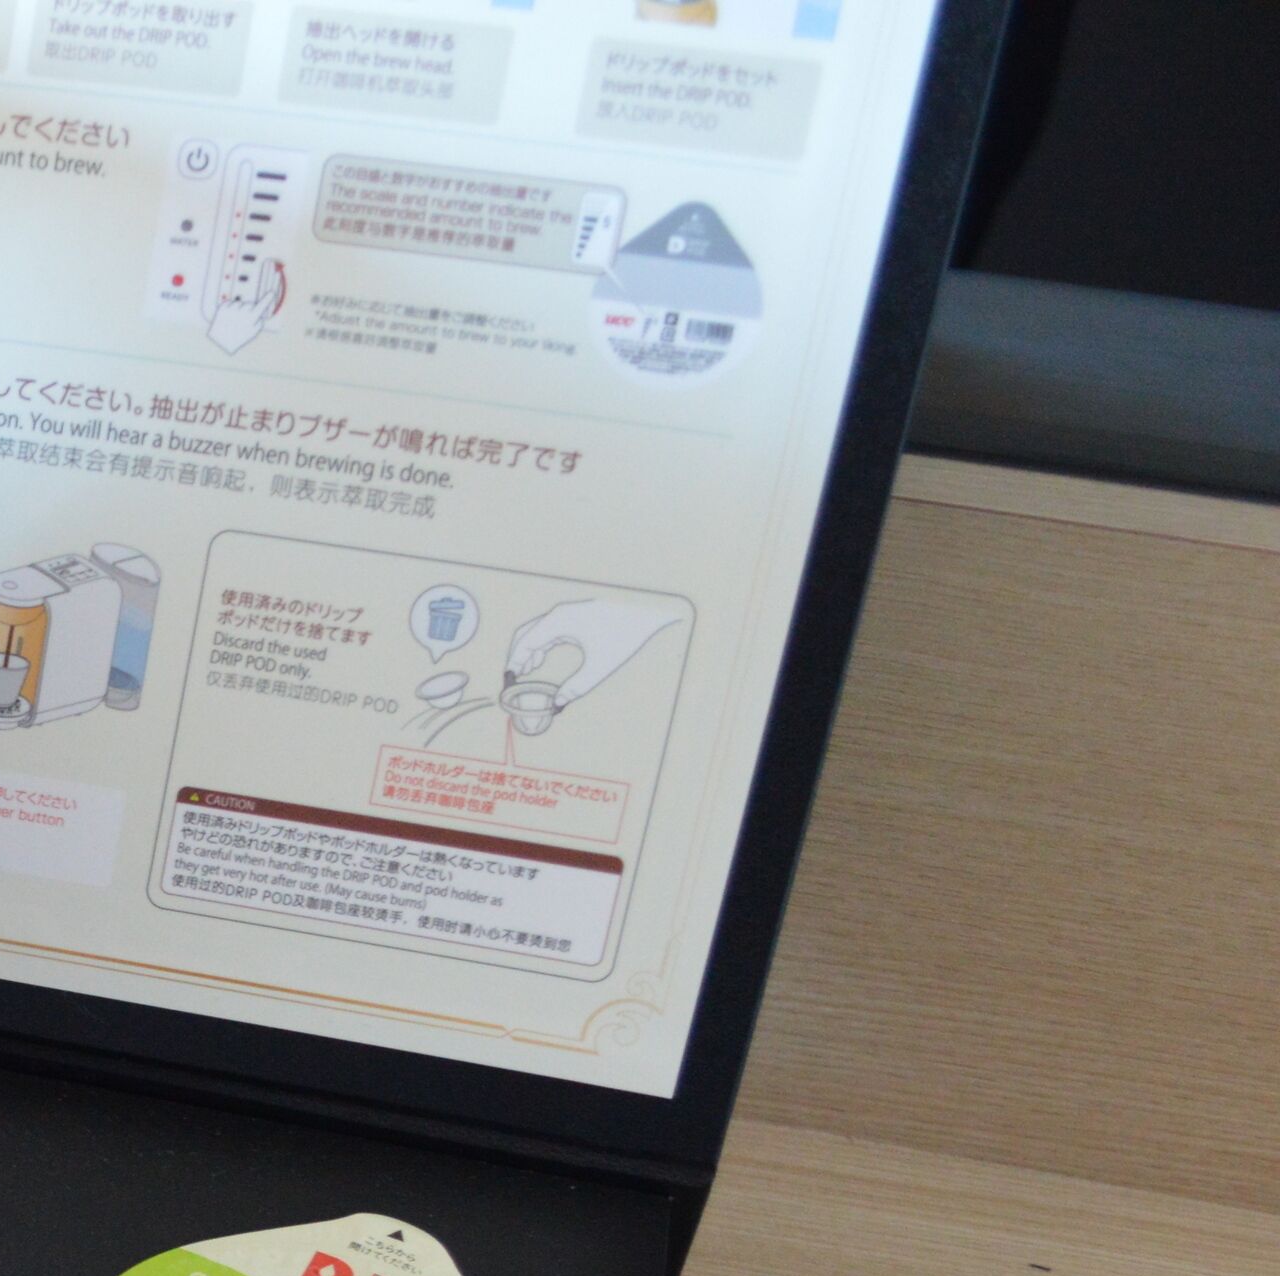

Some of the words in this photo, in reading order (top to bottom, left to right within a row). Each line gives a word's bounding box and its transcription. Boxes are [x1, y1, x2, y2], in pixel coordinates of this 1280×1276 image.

[28, 152, 49, 170] to
[53, 153, 106, 177] brew.
[29, 411, 66, 435] You
[70, 415, 102, 440] will
[106, 425, 147, 448] hear
[151, 435, 163, 450] a
[167, 432, 233, 459] buzzer
[238, 442, 290, 467] when
[295, 447, 376, 482] brewing
[379, 459, 396, 480] is
[399, 462, 454, 489] done.
[213, 630, 265, 653] Discard
[267, 639, 291, 656] the
[294, 646, 328, 662] used
[209, 649, 242, 667] DRIP
[245, 655, 276, 673] POD
[279, 662, 313, 681] only.
[362, 695, 400, 714] POD
[205, 793, 256, 811] CAUTION
[176, 841, 192, 855] Be
[193, 844, 232, 862] careful
[234, 851, 266, 867] when
[268, 855, 319, 878] handling
[321, 866, 340, 880] the
[342, 869, 370, 884] DRIP
[372, 873, 399, 889] POD
[400, 879, 423, 894] and
[424, 884, 449, 900] pod
[450, 886, 488, 905] holder
